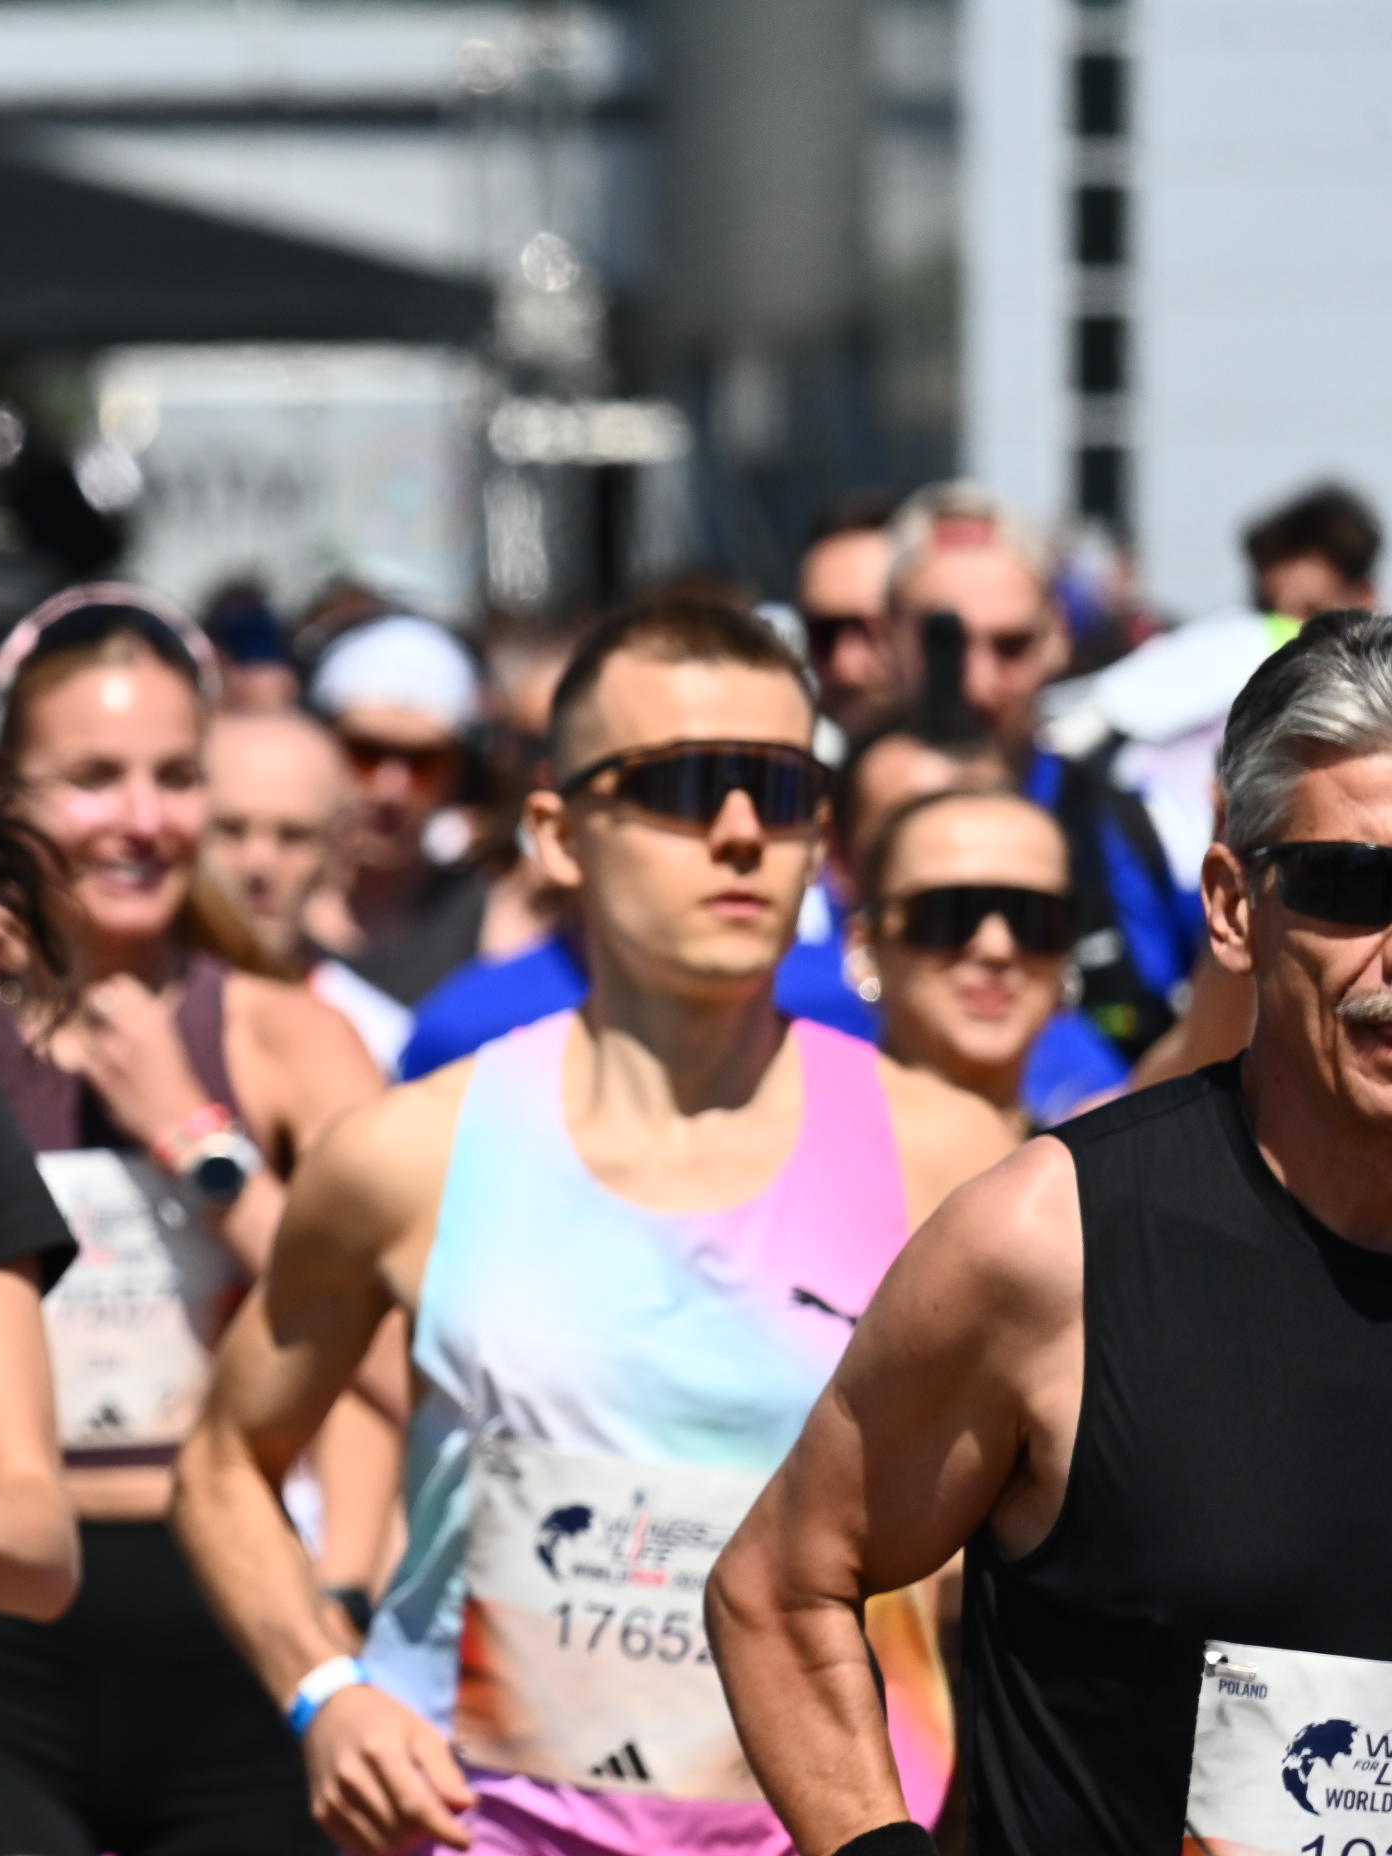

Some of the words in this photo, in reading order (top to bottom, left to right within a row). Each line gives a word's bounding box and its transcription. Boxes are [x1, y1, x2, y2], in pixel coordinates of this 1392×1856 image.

[1218, 1679, 1268, 1699] POLAND
[1352, 1760, 1380, 1771] FOR
[1325, 1787, 1392, 1813] WORLD
